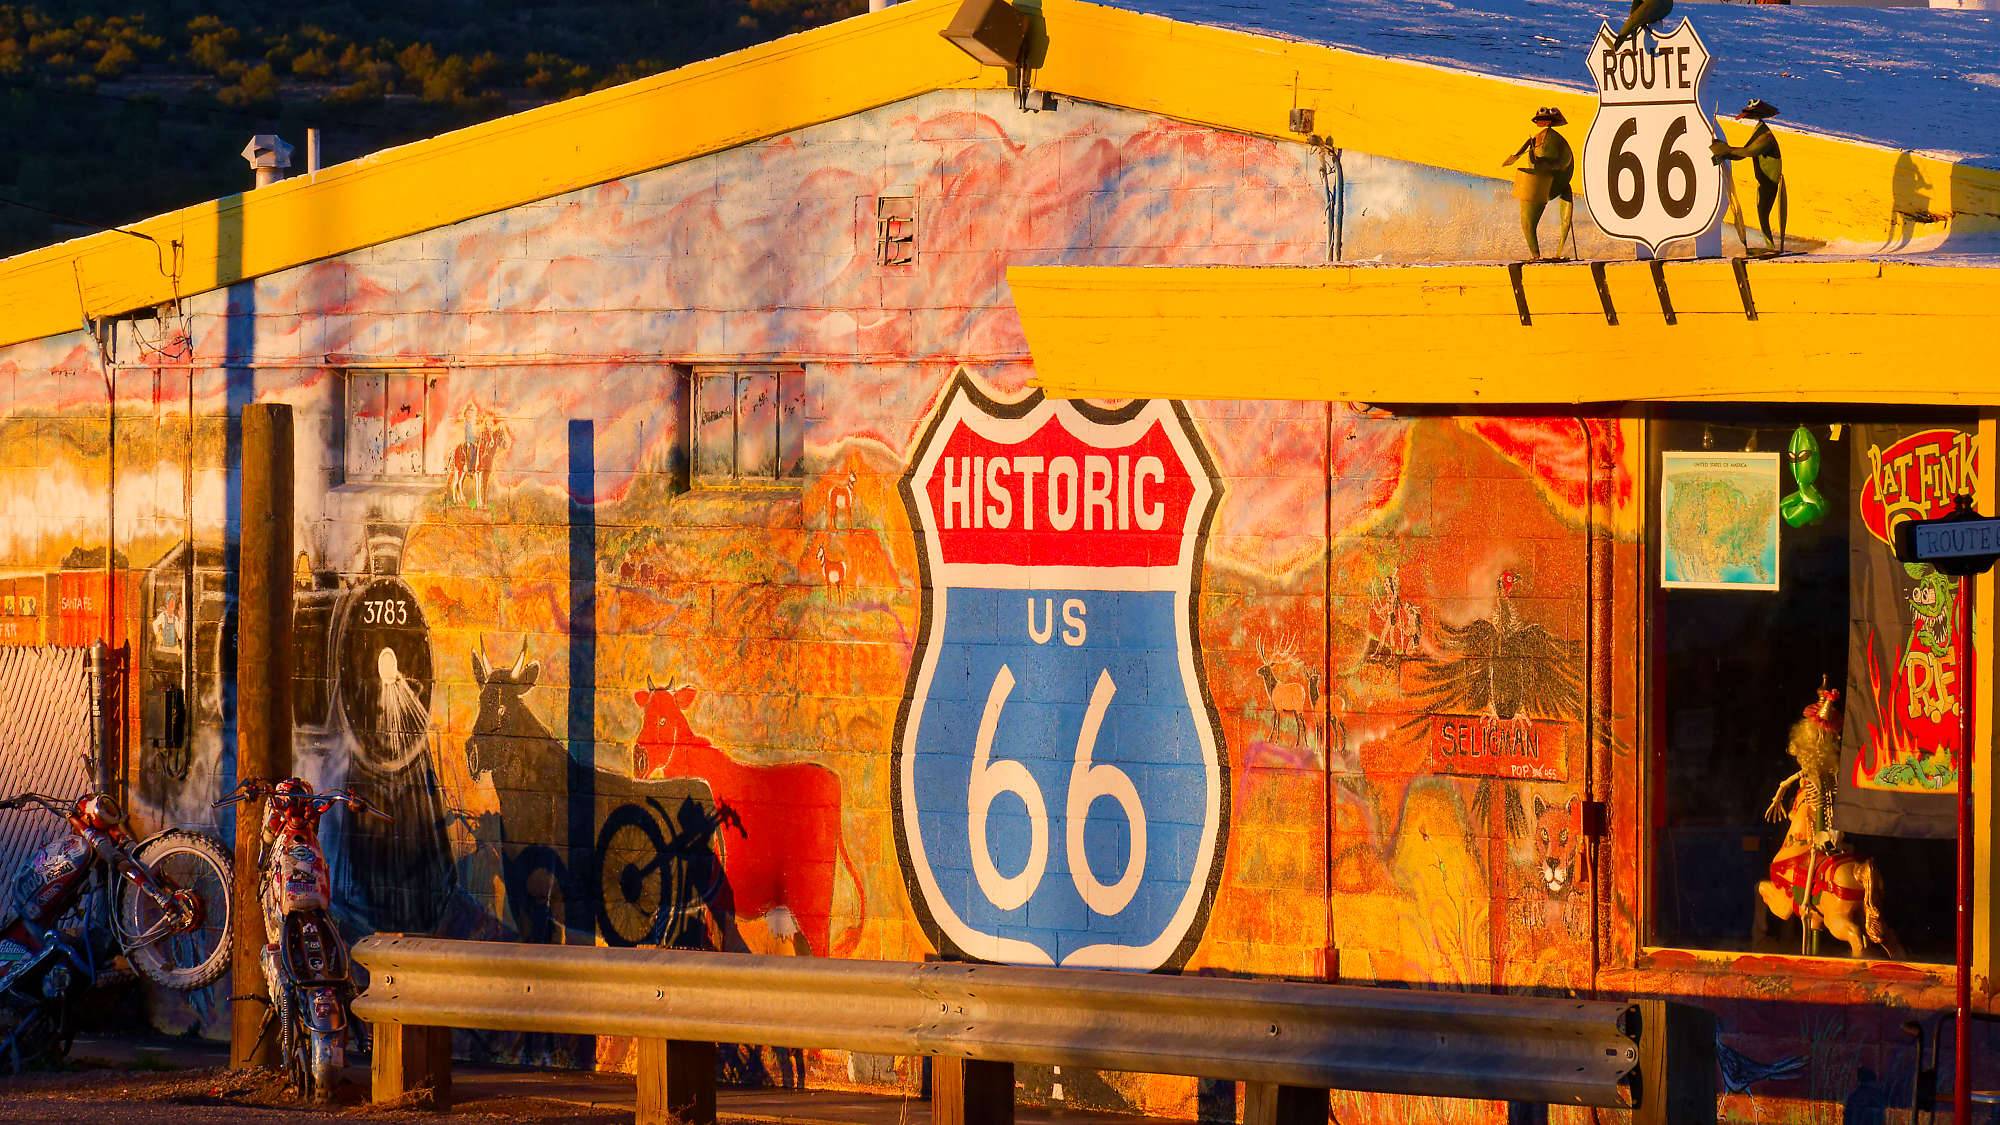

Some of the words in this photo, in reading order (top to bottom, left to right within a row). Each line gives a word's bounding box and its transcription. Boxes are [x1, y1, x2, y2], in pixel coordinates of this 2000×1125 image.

[1603, 47, 1691, 91] ROUTE
[1608, 116, 1697, 219] 66
[943, 455, 1165, 532] HISTORIC
[1915, 432, 1979, 510] FINK
[1925, 527, 1991, 554] ROUTE
[61, 597, 83, 611] SANTA
[83, 596, 93, 611] FE
[363, 599, 407, 625] 3783
[1027, 598, 1087, 647] US
[1441, 721, 1539, 758] SELIGMAN
[967, 663, 1147, 916] 66
